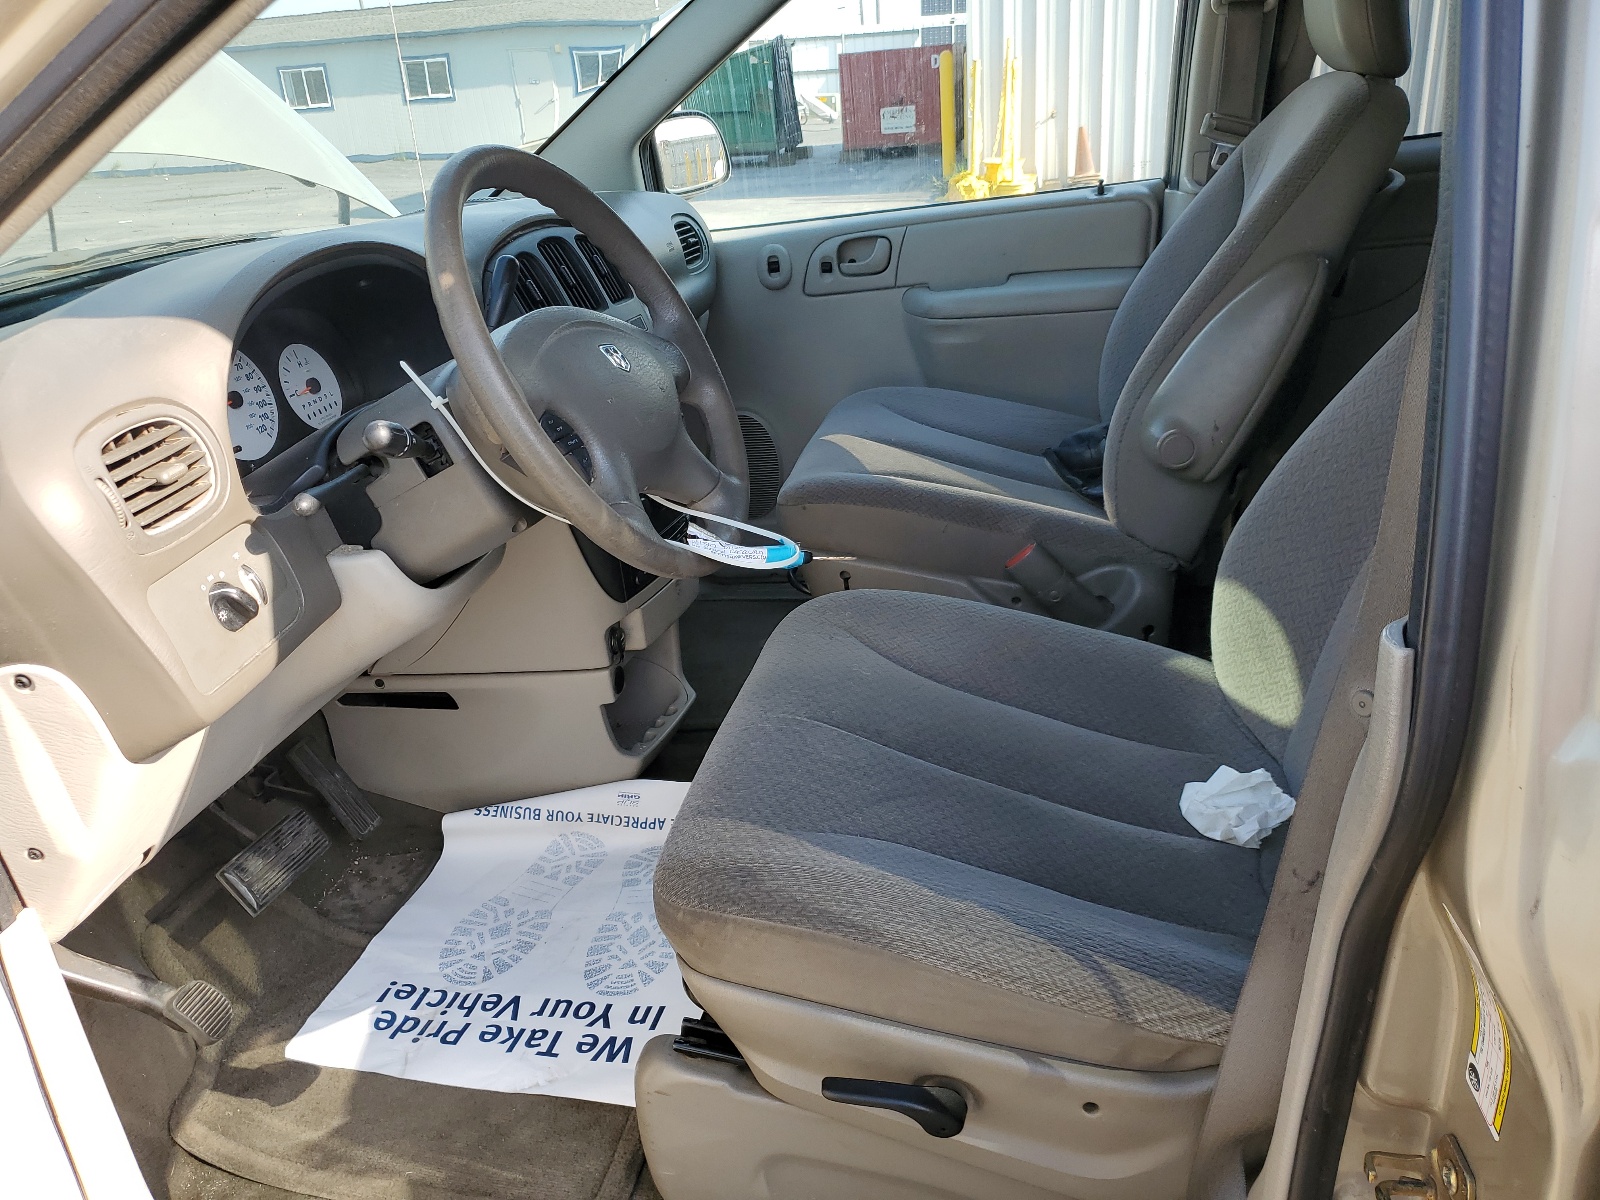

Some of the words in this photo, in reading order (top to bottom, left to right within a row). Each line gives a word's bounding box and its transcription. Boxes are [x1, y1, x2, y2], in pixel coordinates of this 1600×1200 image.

[234, 362, 243, 371] 70
[245, 372, 253, 381] 80
[253, 385, 262, 393] 90
[256, 399, 267, 409] 100
[259, 412, 270, 422] 110
[256, 424, 267, 434] 120
[474, 805, 541, 821] BUSINESS
[546, 809, 583, 823] YOUR
[587, 811, 666, 831] APPRECIATE
[375, 980, 523, 1022] Vehicle!
[531, 996, 615, 1029] Your
[627, 1004, 666, 1032] In
[372, 1009, 471, 1047] Pride
[478, 1023, 563, 1059] Take
[575, 1032, 635, 1065] We
